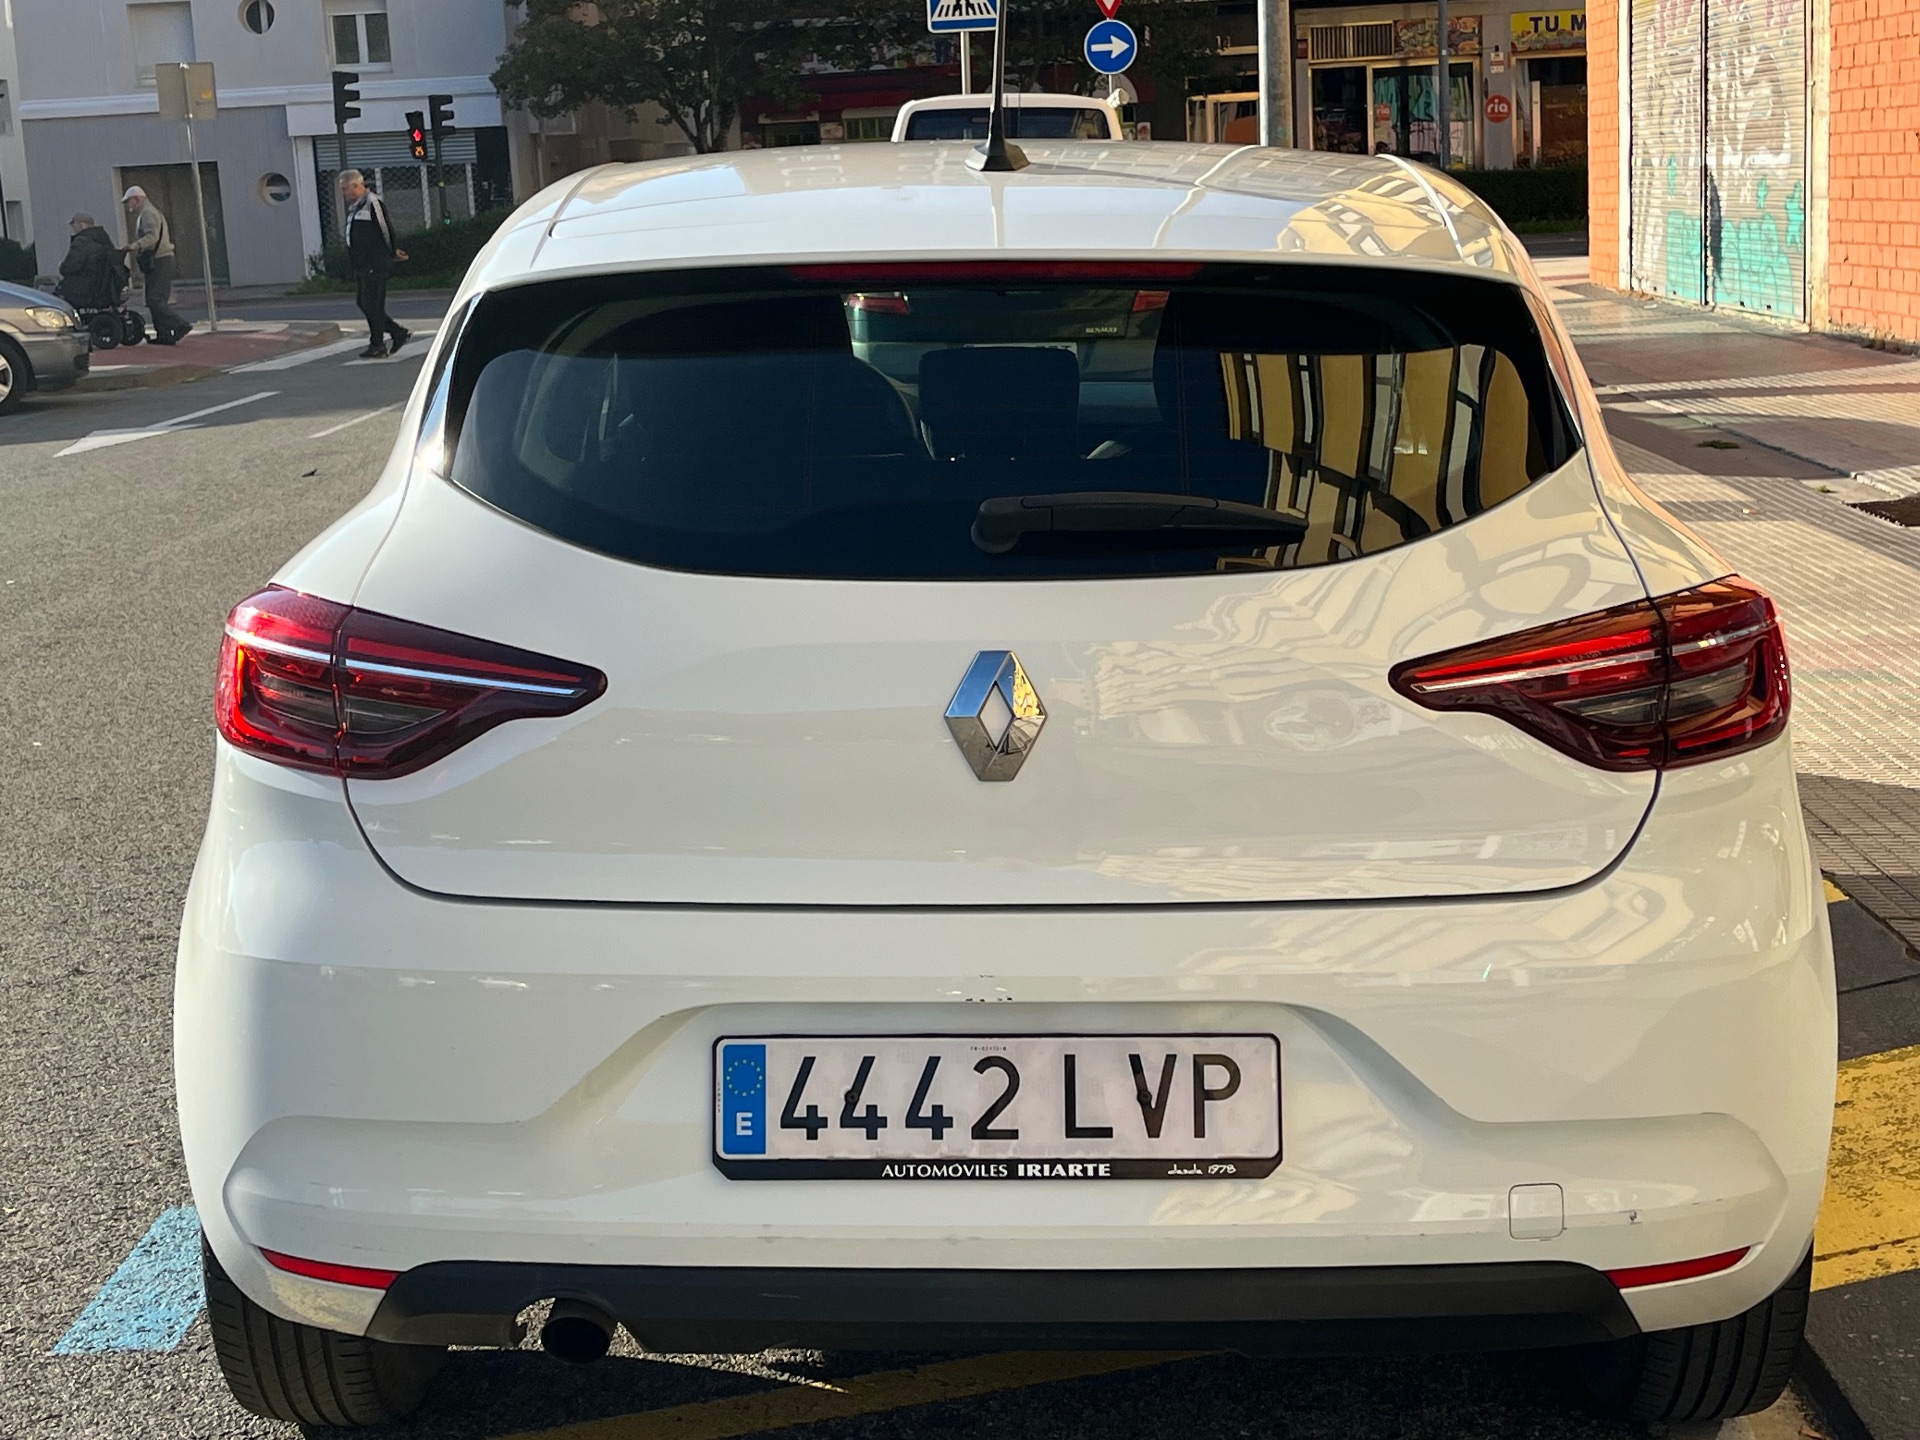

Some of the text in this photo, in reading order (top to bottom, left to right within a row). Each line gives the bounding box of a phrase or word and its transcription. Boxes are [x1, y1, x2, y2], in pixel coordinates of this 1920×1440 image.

[1528, 15, 1559, 33] TU
[1487, 98, 1509, 114] ria
[780, 1053, 1241, 1141] 4442 LVP
[736, 1112, 753, 1136] E
[881, 1162, 1008, 1178] AUTOMÓVILES
[1017, 1163, 1111, 1177] IRIARTE
[1207, 1163, 1237, 1175] 1978
